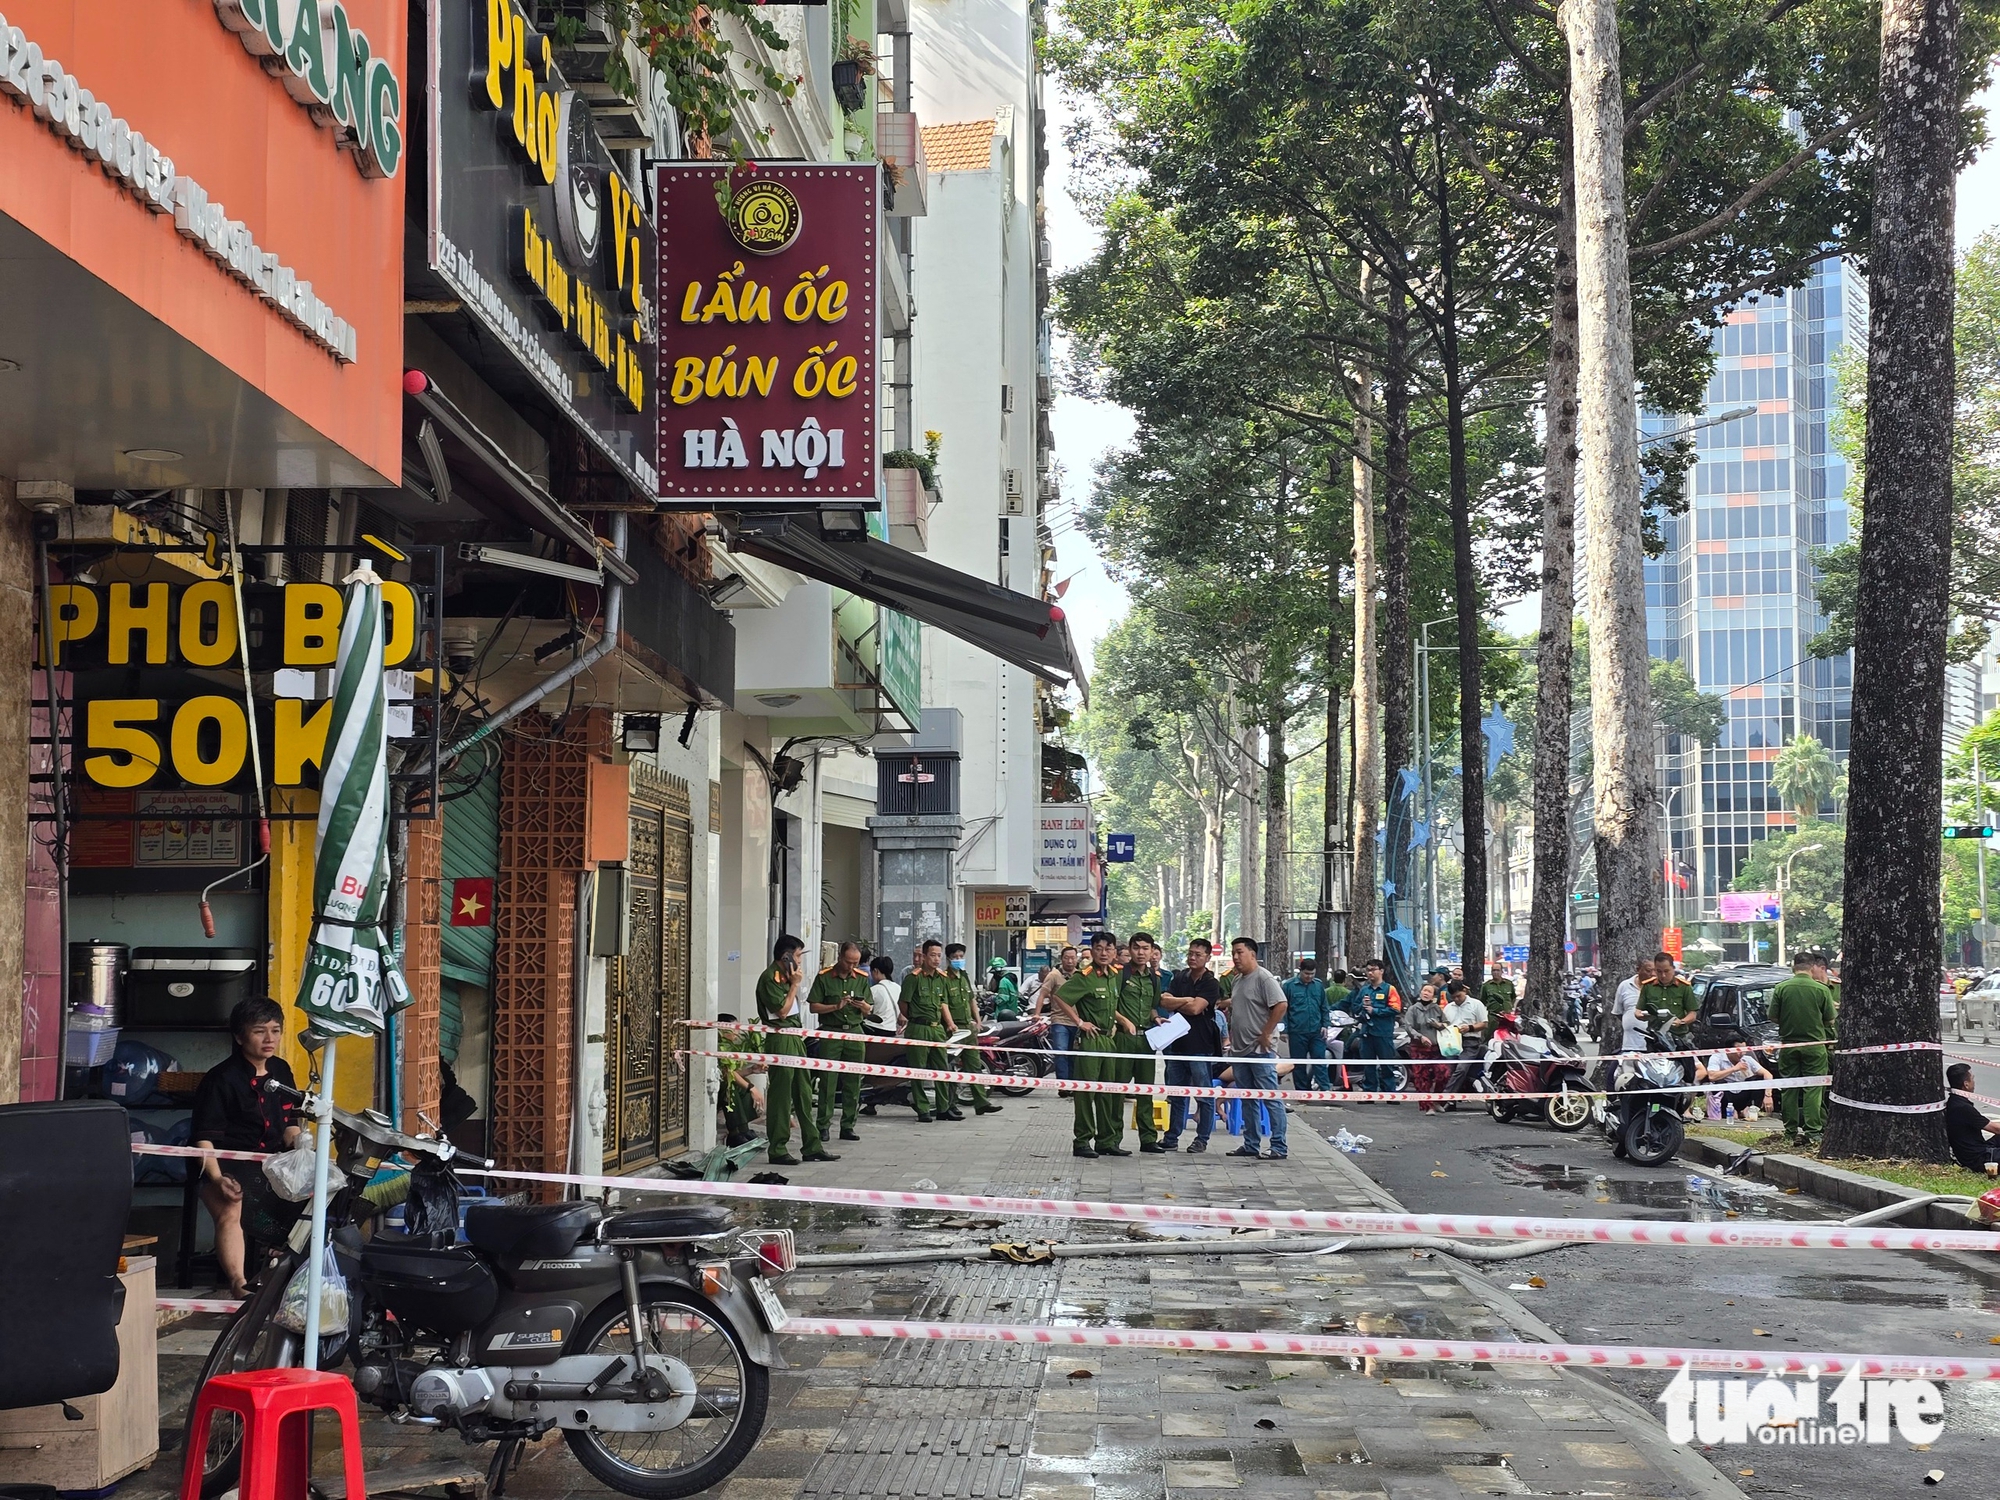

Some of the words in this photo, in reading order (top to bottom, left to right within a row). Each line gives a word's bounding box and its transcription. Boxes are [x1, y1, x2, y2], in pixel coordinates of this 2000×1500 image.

[784, 265, 849, 323] ỐC
[671, 345, 779, 406] BÚN
[793, 340, 857, 398] ỐC
[684, 417, 749, 468] HÀ
[761, 417, 846, 479] NỘI
[1044, 838, 1064, 851] DỤNG
[1067, 838, 1077, 851] CỤ
[976, 902, 1001, 920] GẤP
[541, 1262, 583, 1270] HONDA
[517, 1332, 551, 1340] SUPER
